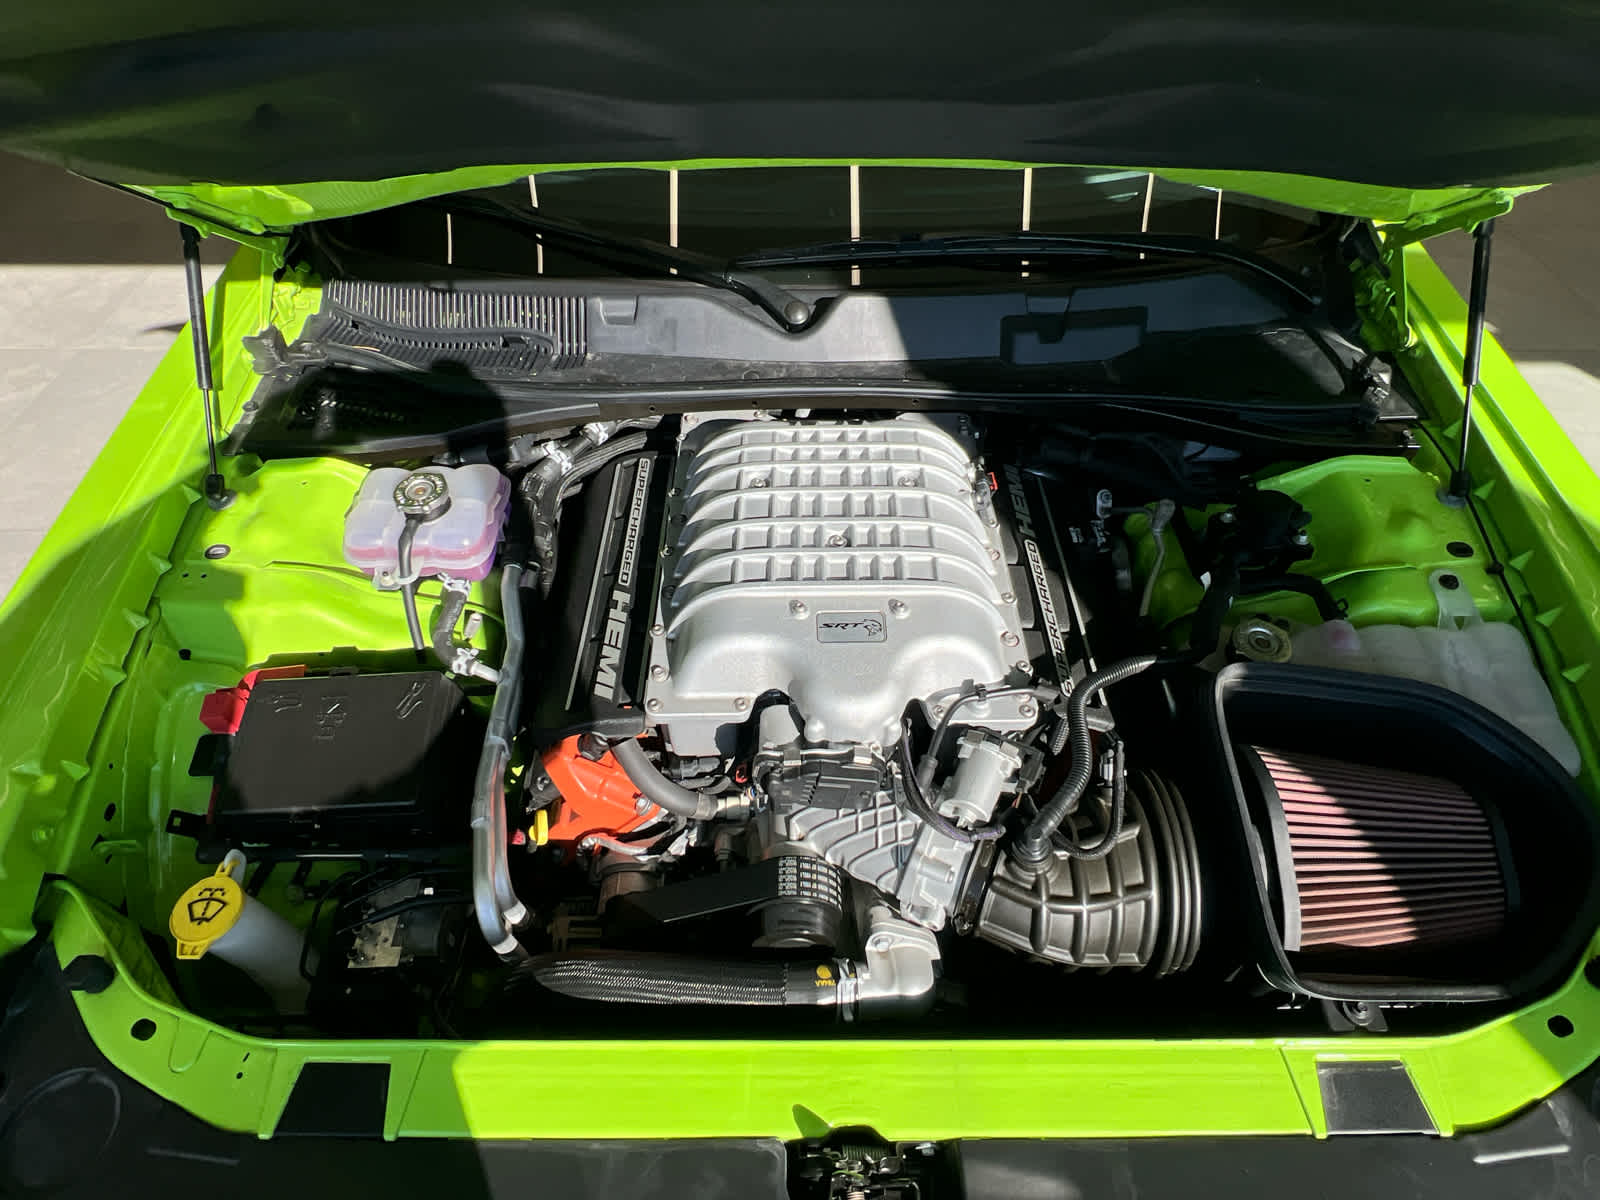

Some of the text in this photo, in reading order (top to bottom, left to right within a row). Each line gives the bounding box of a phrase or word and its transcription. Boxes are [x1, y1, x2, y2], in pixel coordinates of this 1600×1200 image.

[594, 458, 650, 701] SUPERCHARGED HEMI
[820, 621, 864, 630] SRT
[1003, 464, 1075, 696] SUPERCHARGED HEMI
